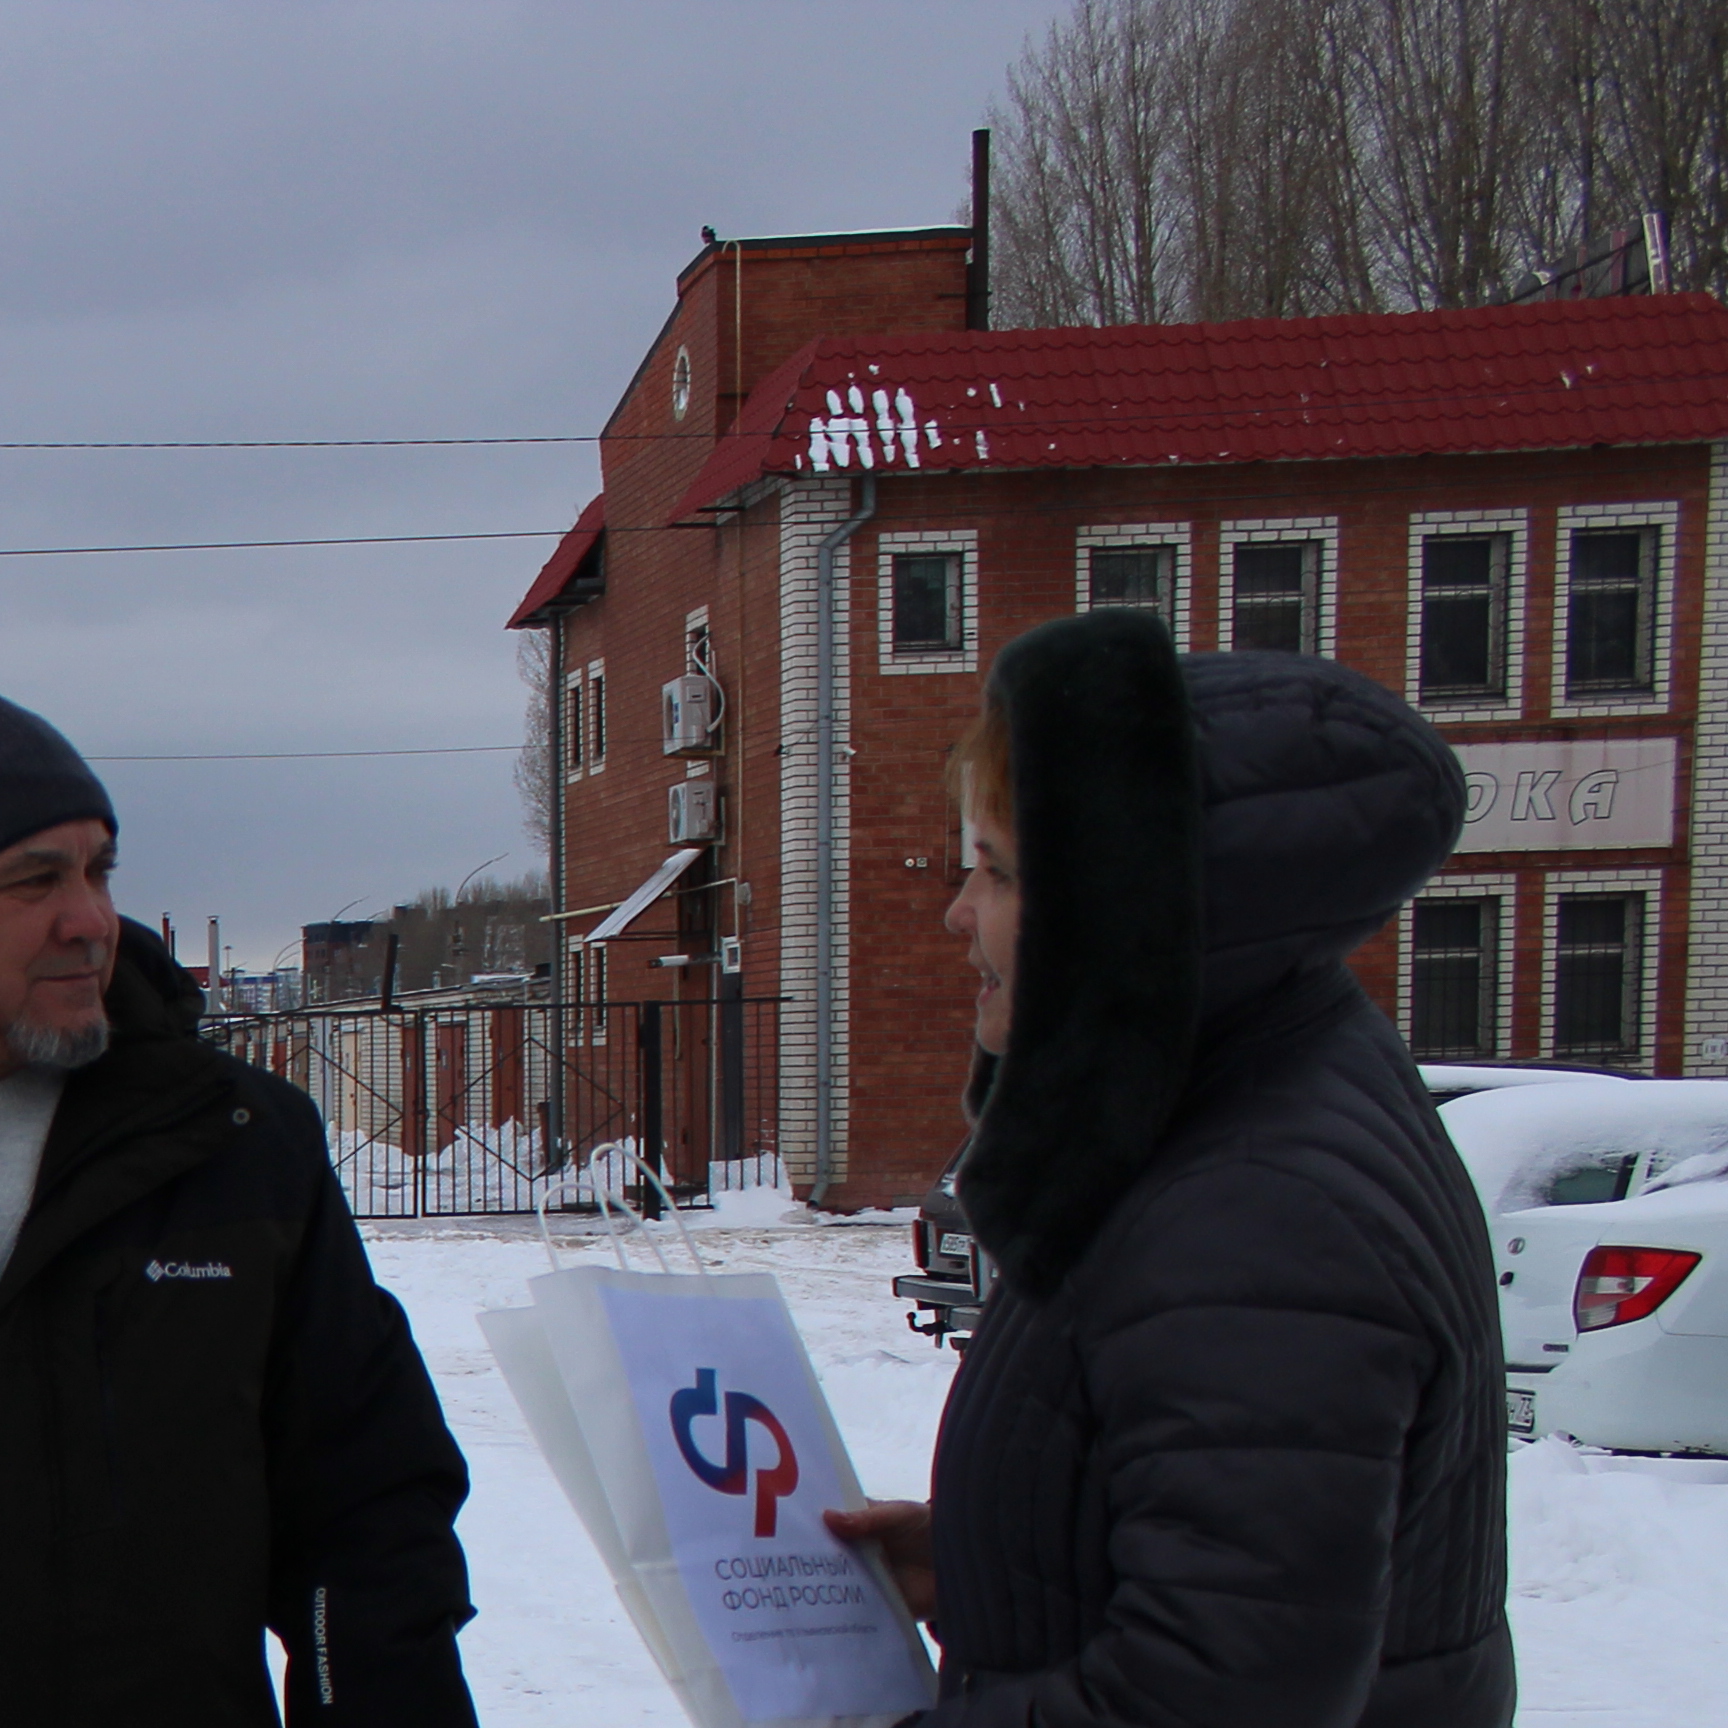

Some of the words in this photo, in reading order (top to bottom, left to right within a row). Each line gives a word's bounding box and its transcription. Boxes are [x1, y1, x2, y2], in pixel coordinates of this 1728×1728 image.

[165, 1262, 233, 1278] Columbia
[715, 1554, 856, 1581] СОЦИАЛЬНЫЙ
[722, 1588, 789, 1611] ФОНД
[790, 1584, 865, 1607] РОССИИ
[314, 1587, 327, 1646] OUTDOOR
[317, 1647, 333, 1704] FASHION
